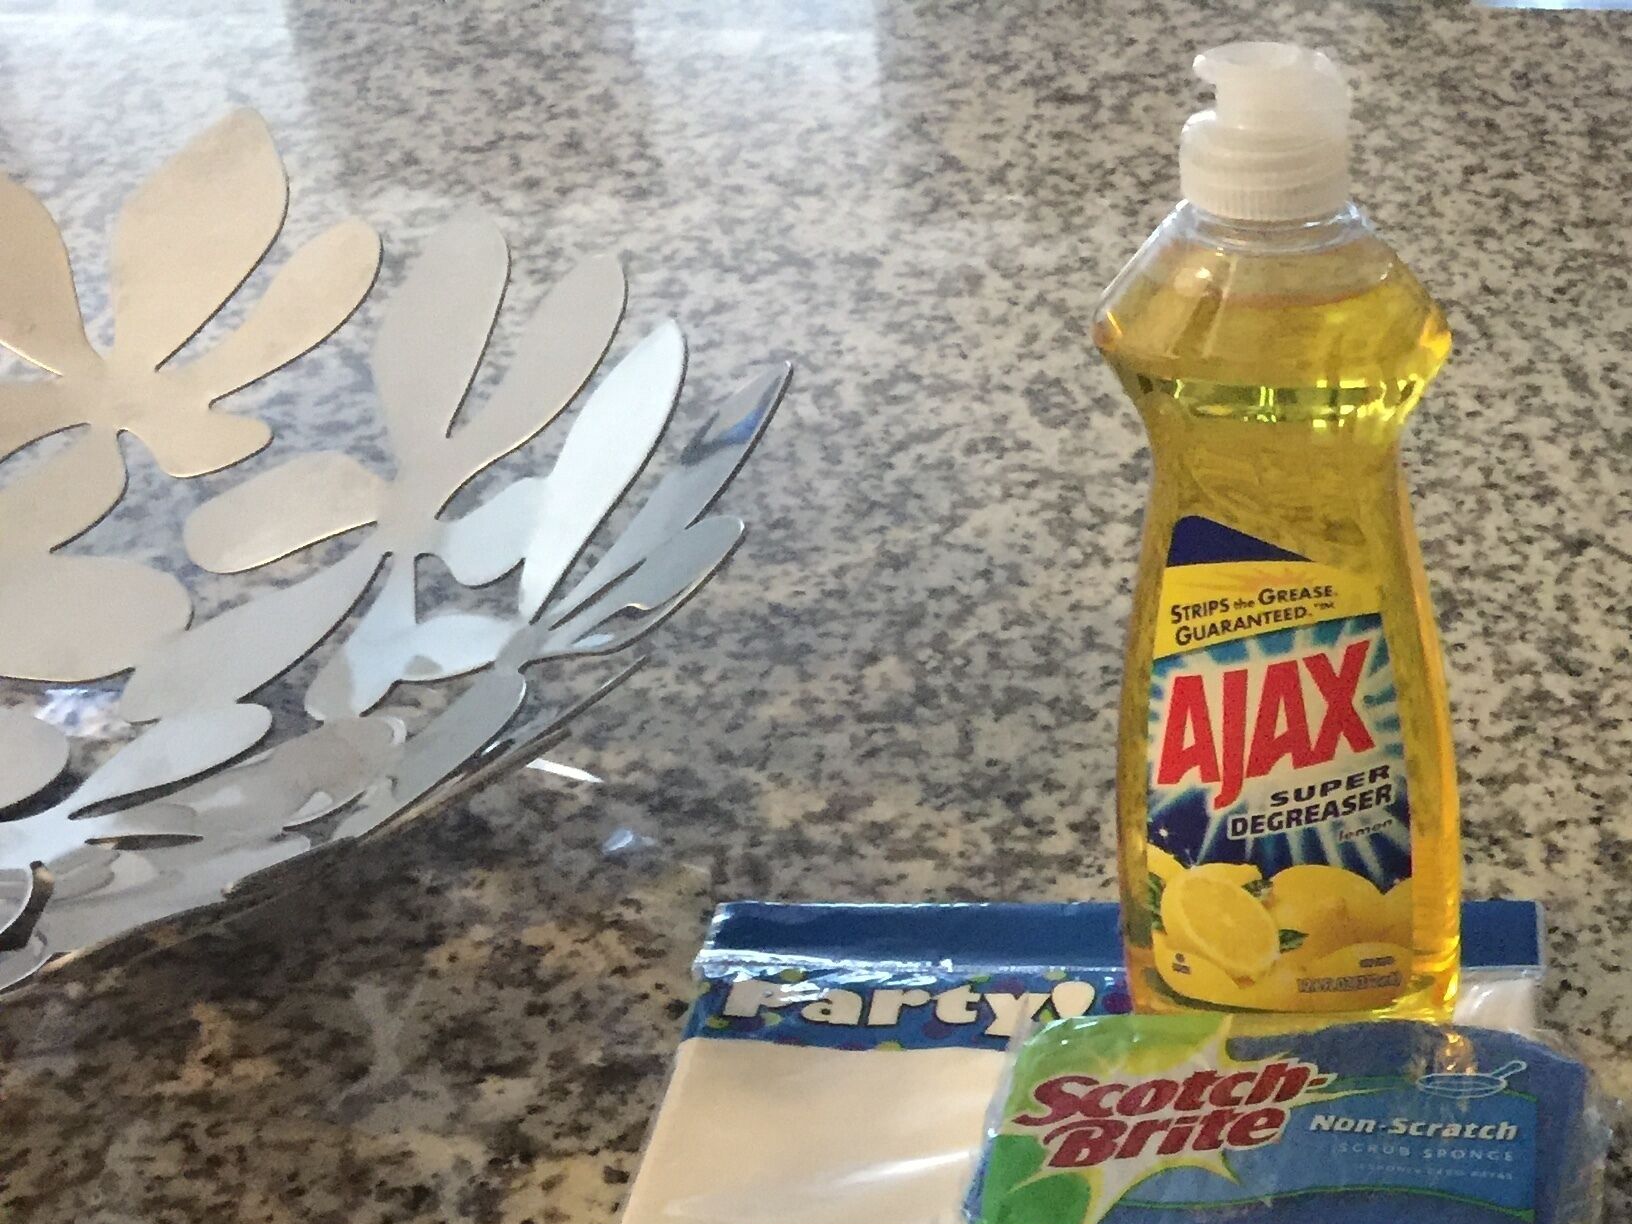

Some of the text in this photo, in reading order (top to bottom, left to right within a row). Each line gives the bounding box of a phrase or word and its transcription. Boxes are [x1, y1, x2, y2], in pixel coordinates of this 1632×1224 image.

[1171, 598, 1230, 624] STRIPS
[1233, 597, 1255, 609] the
[1157, 640, 1376, 810] AJAX
[1270, 765, 1390, 807] SUPER
[1231, 783, 1393, 837] DEGREASER
[1339, 819, 1393, 841] lemon
[1043, 1108, 1286, 1167] Brite
[1309, 1115, 1518, 1140] Non-Scratch
[1337, 1142, 1513, 1171] SCRUB SPONGE
